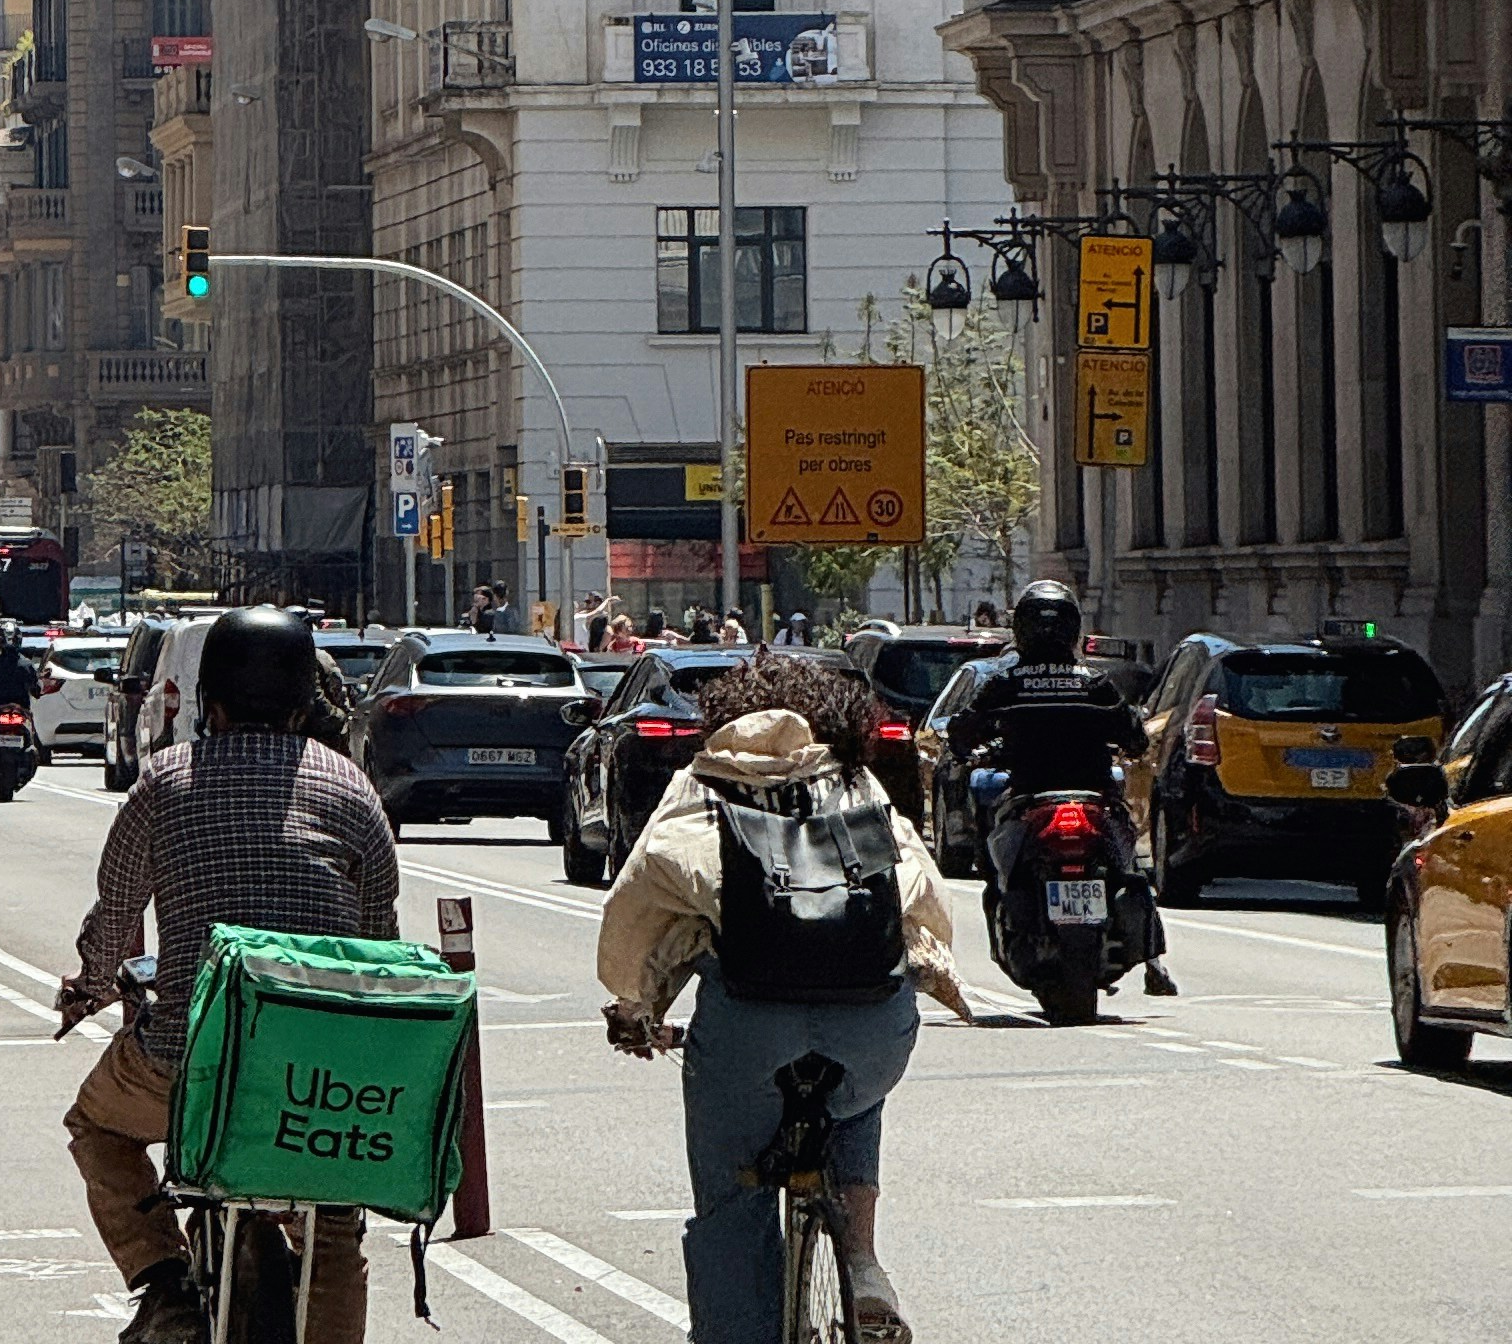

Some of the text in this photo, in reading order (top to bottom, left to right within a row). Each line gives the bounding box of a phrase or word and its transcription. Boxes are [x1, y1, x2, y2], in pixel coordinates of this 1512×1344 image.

[641, 39, 699, 52] Oficinas
[643, 59, 677, 76] 933
[684, 59, 705, 76] 18
[739, 59, 762, 76] 53
[806, 378, 865, 396] ATENCIÓ
[784, 429, 886, 449] Pas restringit
[799, 456, 872, 475] per obres
[398, 494, 415, 518] P
[874, 499, 896, 517] 30
[1023, 677, 1082, 688] PORTERS
[286, 1062, 405, 1115] Uber
[274, 1110, 394, 1162] Eats
